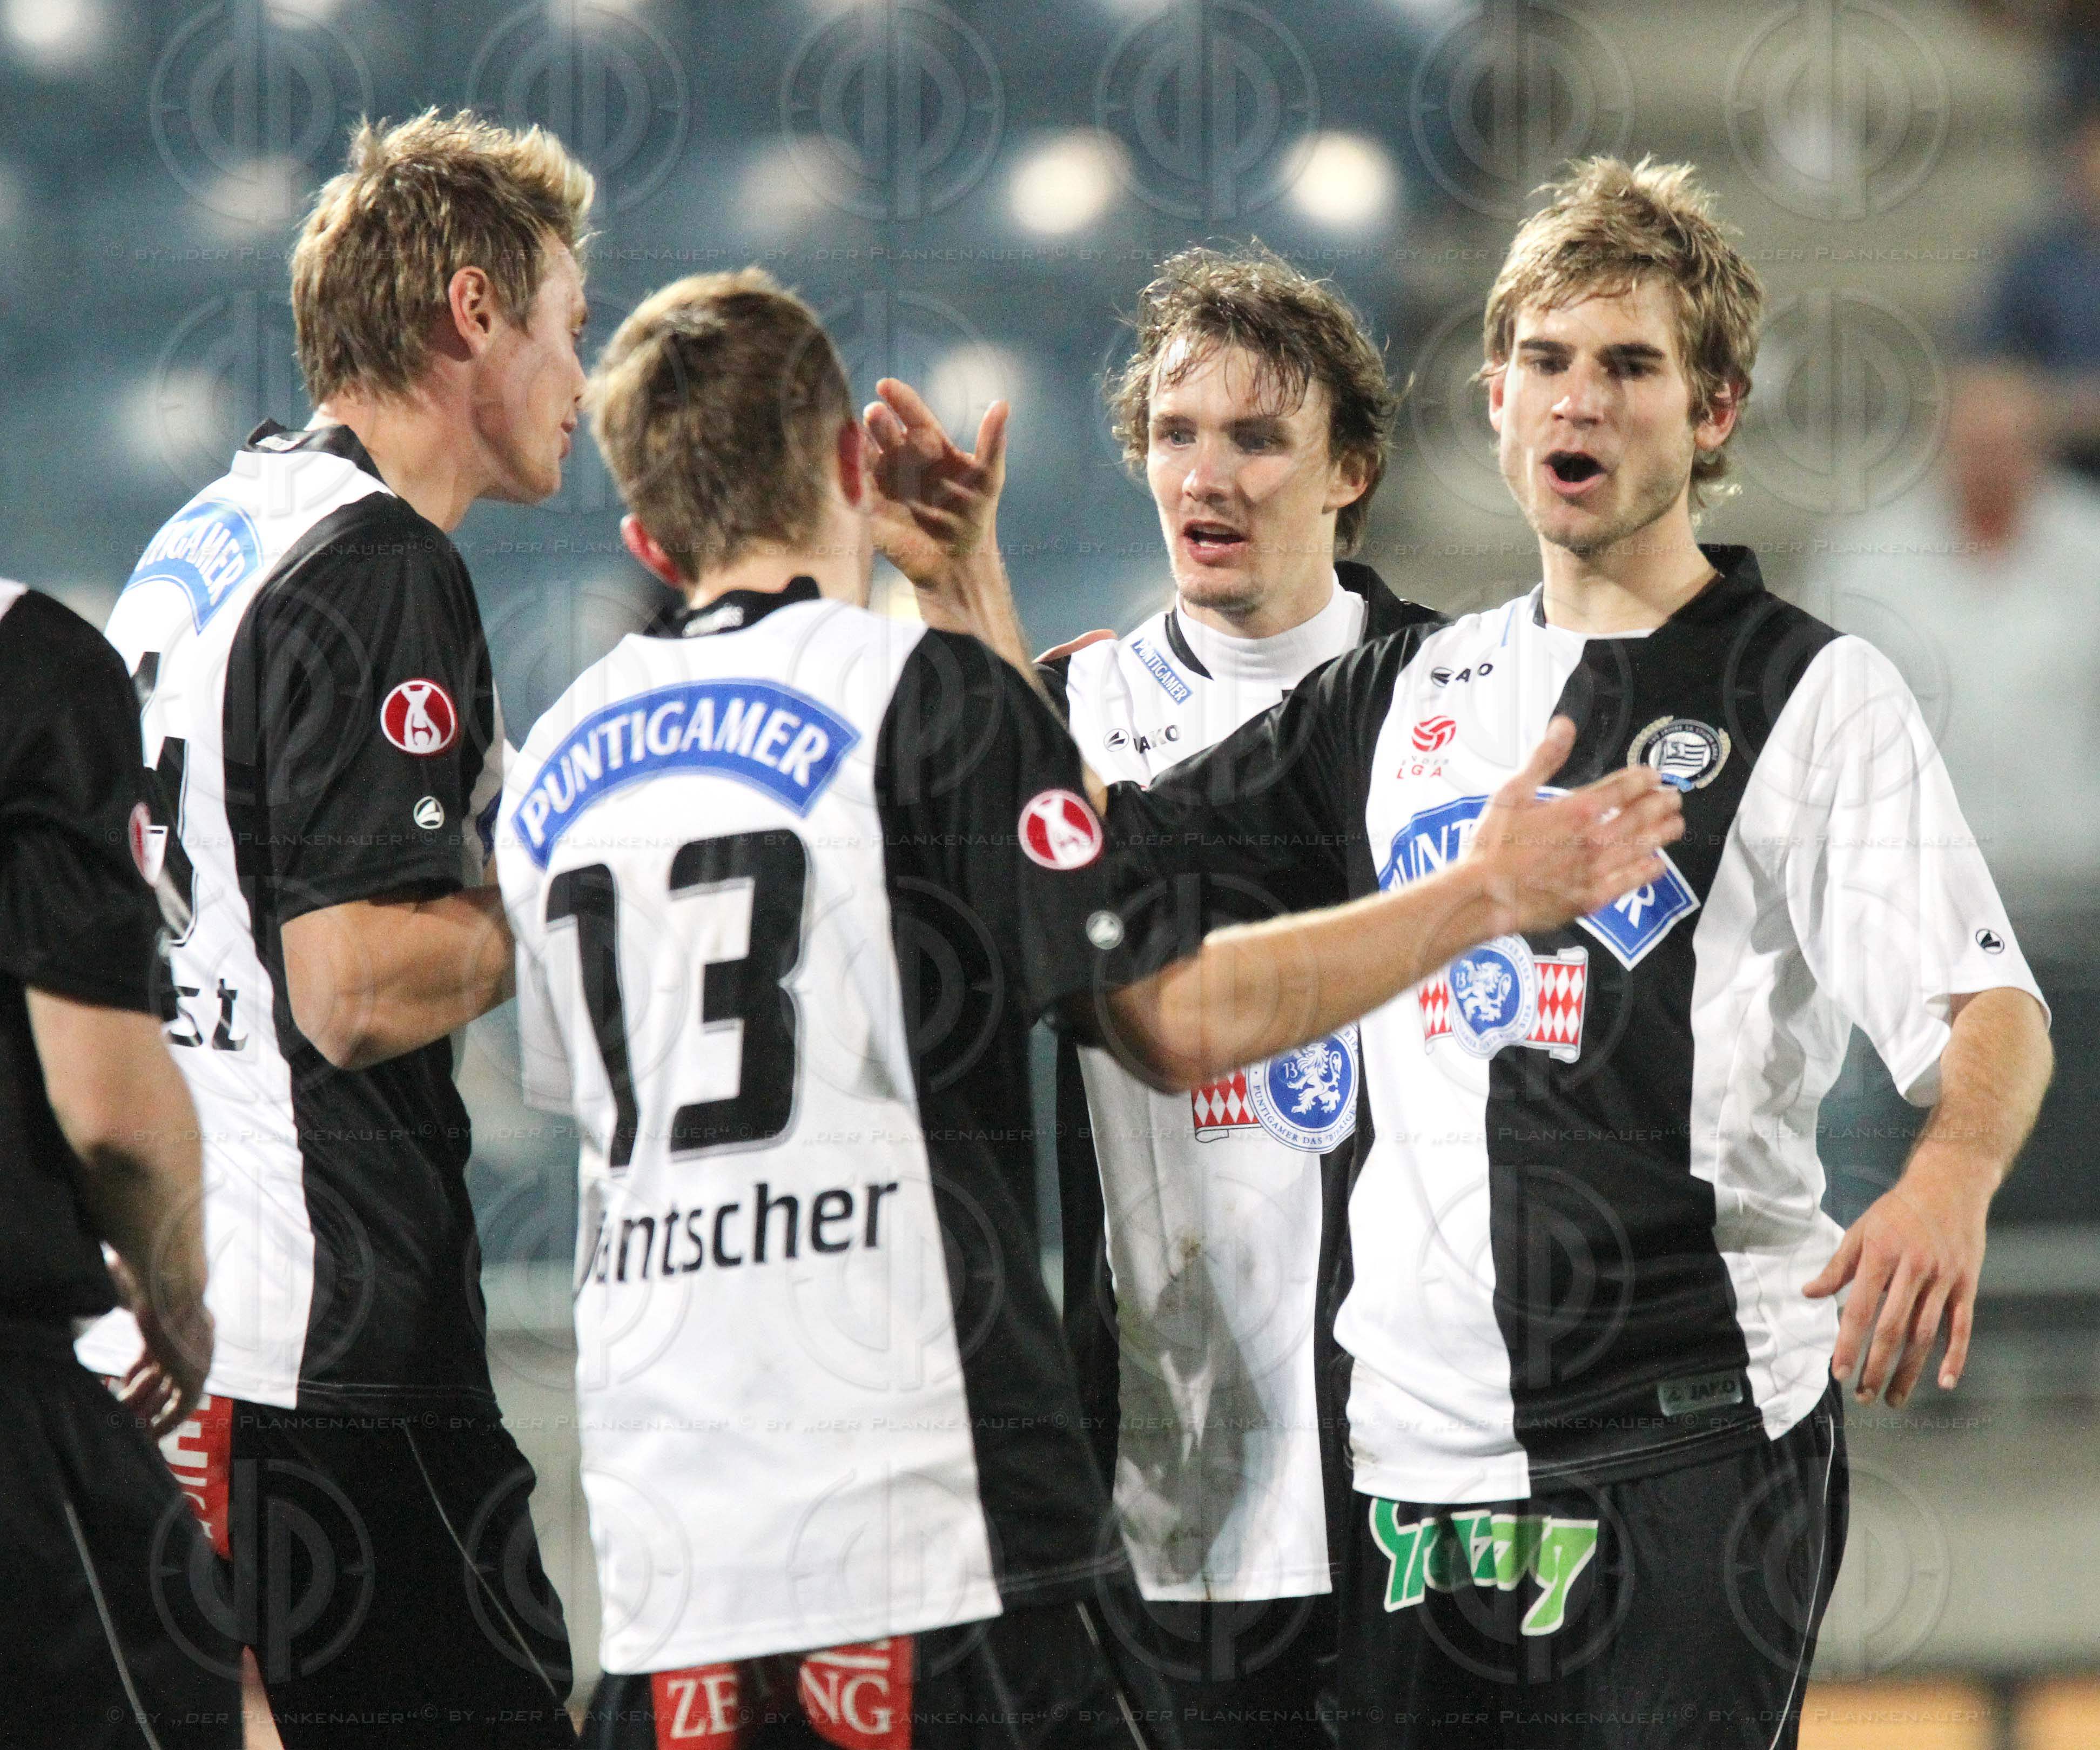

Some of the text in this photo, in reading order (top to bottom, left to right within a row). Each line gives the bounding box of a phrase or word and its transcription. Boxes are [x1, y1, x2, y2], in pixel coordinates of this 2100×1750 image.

[520, 698, 830, 845] PUNTIGAMER
[544, 829, 810, 1171] 13
[1254, 1085, 1298, 1142] PUNTIGAMER
[1303, 1135, 1323, 1145] DAS
